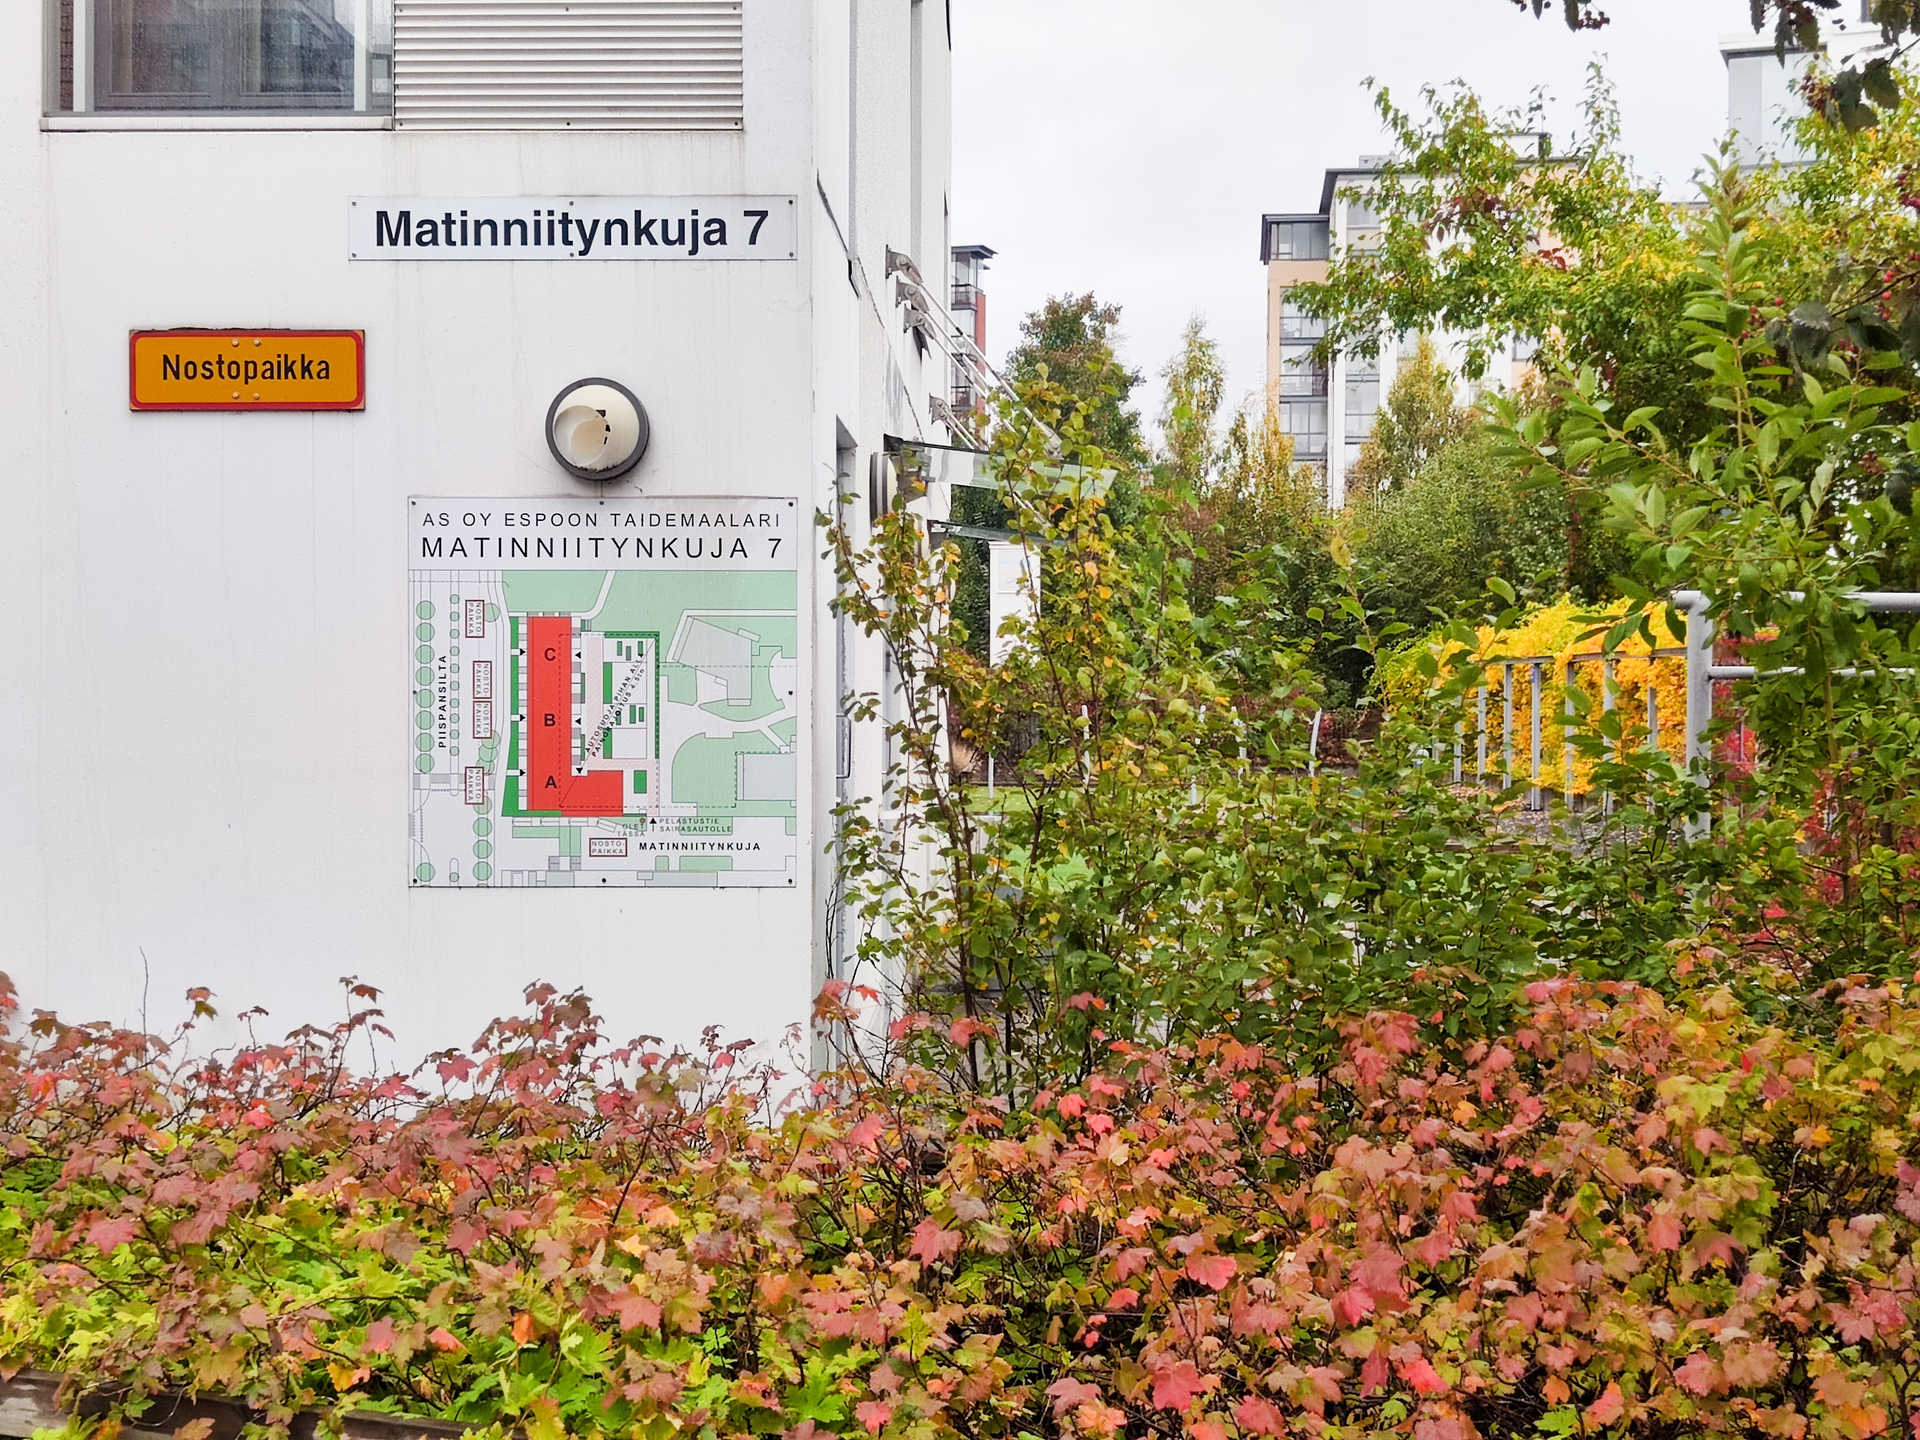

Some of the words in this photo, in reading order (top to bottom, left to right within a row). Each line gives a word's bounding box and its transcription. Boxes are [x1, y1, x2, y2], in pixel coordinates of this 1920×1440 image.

[376, 210, 728, 256] Matinniitynkuja
[743, 210, 769, 246] 7
[162, 353, 331, 385] Nostopaikka
[423, 512, 451, 528] AS
[462, 512, 492, 528] OY
[504, 512, 598, 528] ESPOON
[609, 512, 780, 528] TAIDEMAALARI
[422, 537, 748, 559] MATINNIITYNKUJA
[767, 537, 782, 559] 7
[544, 647, 556, 662] C
[438, 655, 447, 748] PIISPANSILTA
[544, 713, 556, 727] B
[544, 775, 558, 789] A
[639, 842, 761, 851] MATINNIITYNKUJA
